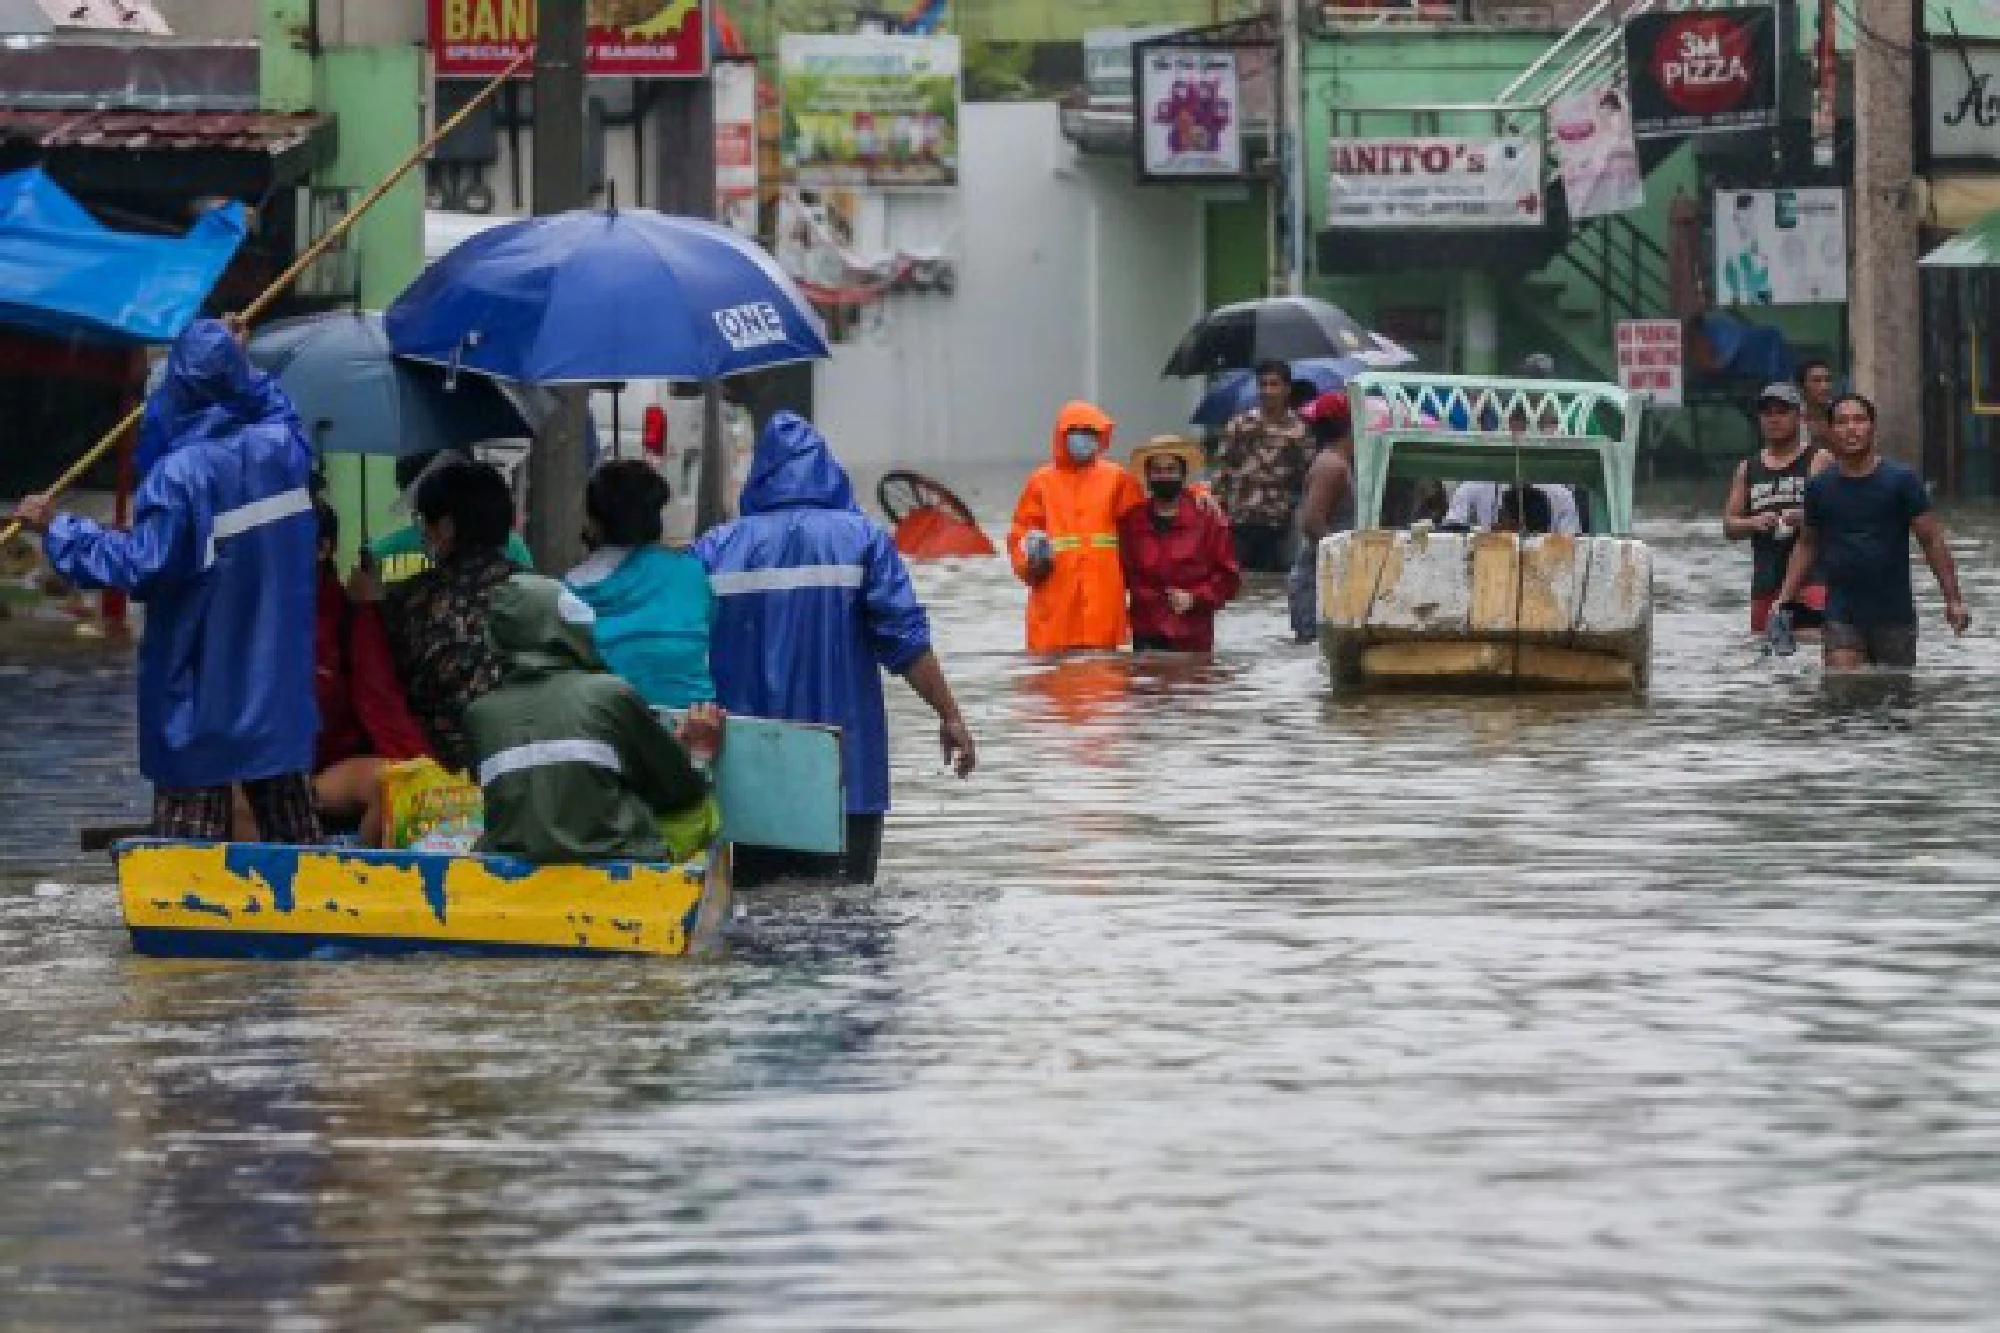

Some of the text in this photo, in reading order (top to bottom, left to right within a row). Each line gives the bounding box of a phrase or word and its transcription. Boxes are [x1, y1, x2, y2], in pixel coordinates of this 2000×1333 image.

[446, 0, 538, 40] BAN
[1681, 31, 1719, 56] 3M
[1663, 55, 1747, 85] PIZZA
[716, 304, 782, 338] ONE
